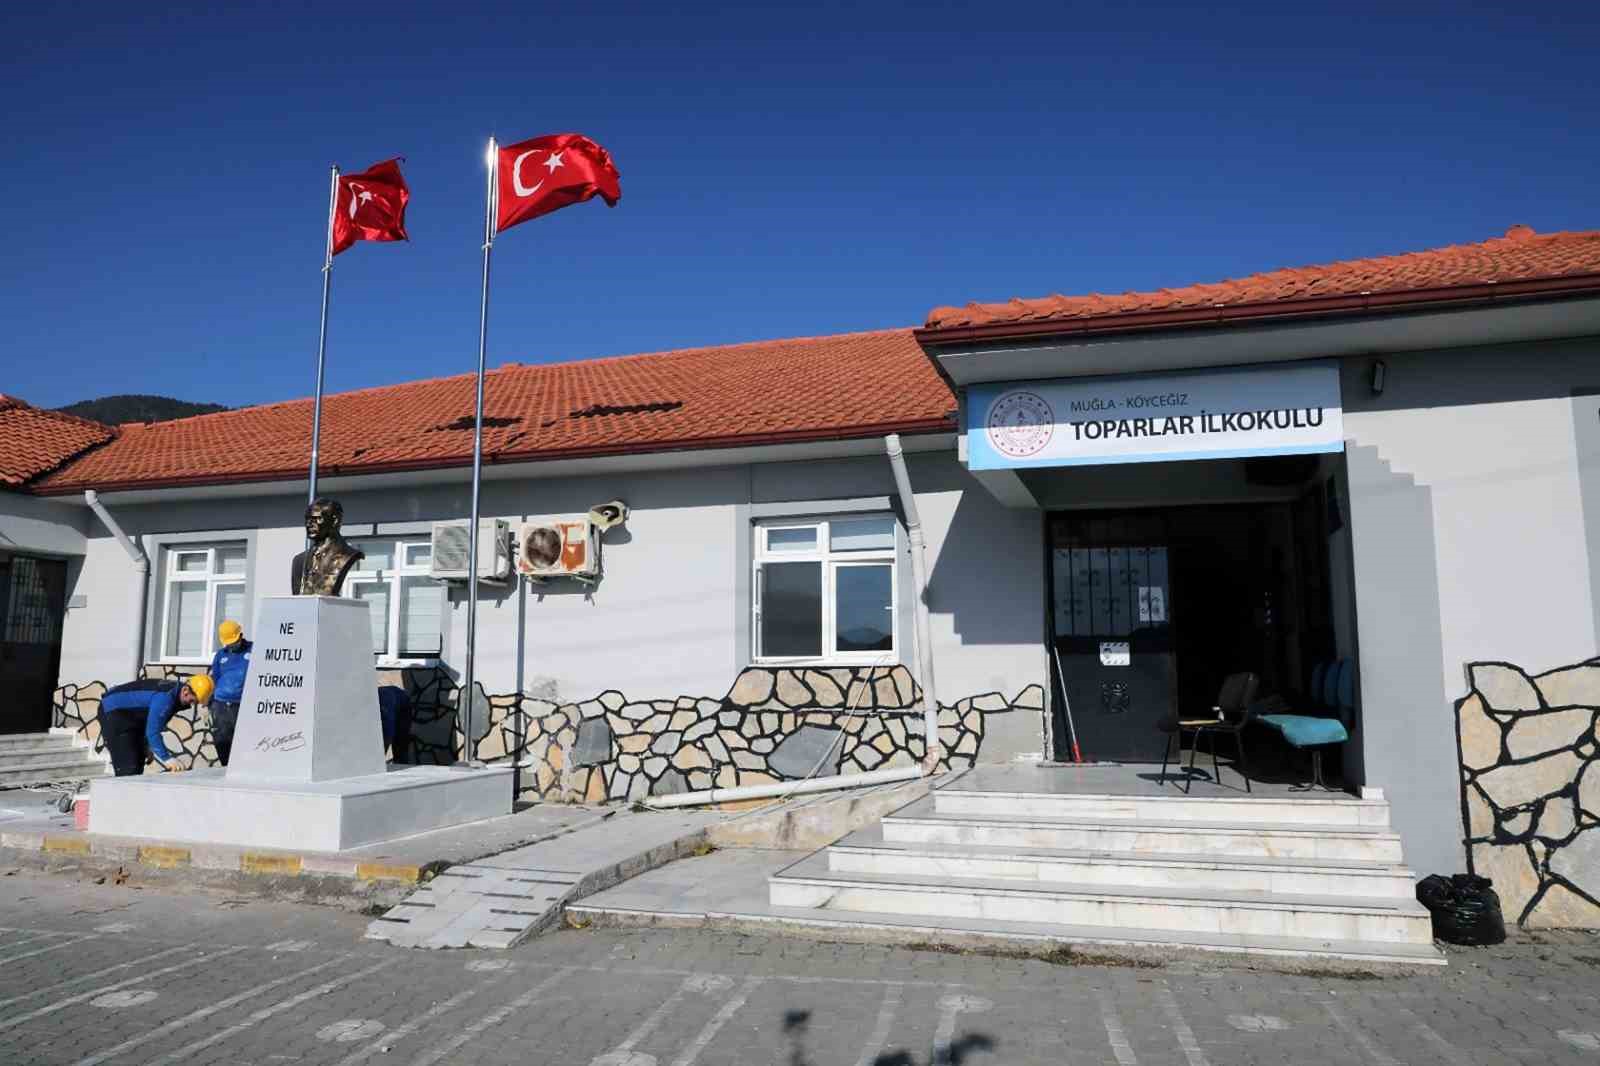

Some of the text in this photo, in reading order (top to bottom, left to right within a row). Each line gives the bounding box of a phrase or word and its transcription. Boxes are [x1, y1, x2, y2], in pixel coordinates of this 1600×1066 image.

[1070, 398, 1117, 412] MUĞLA
[1126, 392, 1190, 409] KÖYCEĞİZ
[1070, 415, 1195, 440] TOPARLAR
[1200, 407, 1323, 433] İLKOKULU
[279, 622, 295, 635] NE
[265, 648, 302, 661] MUTLU
[257, 673, 303, 688] TÜRKÜM
[257, 699, 297, 715] DİYENE
